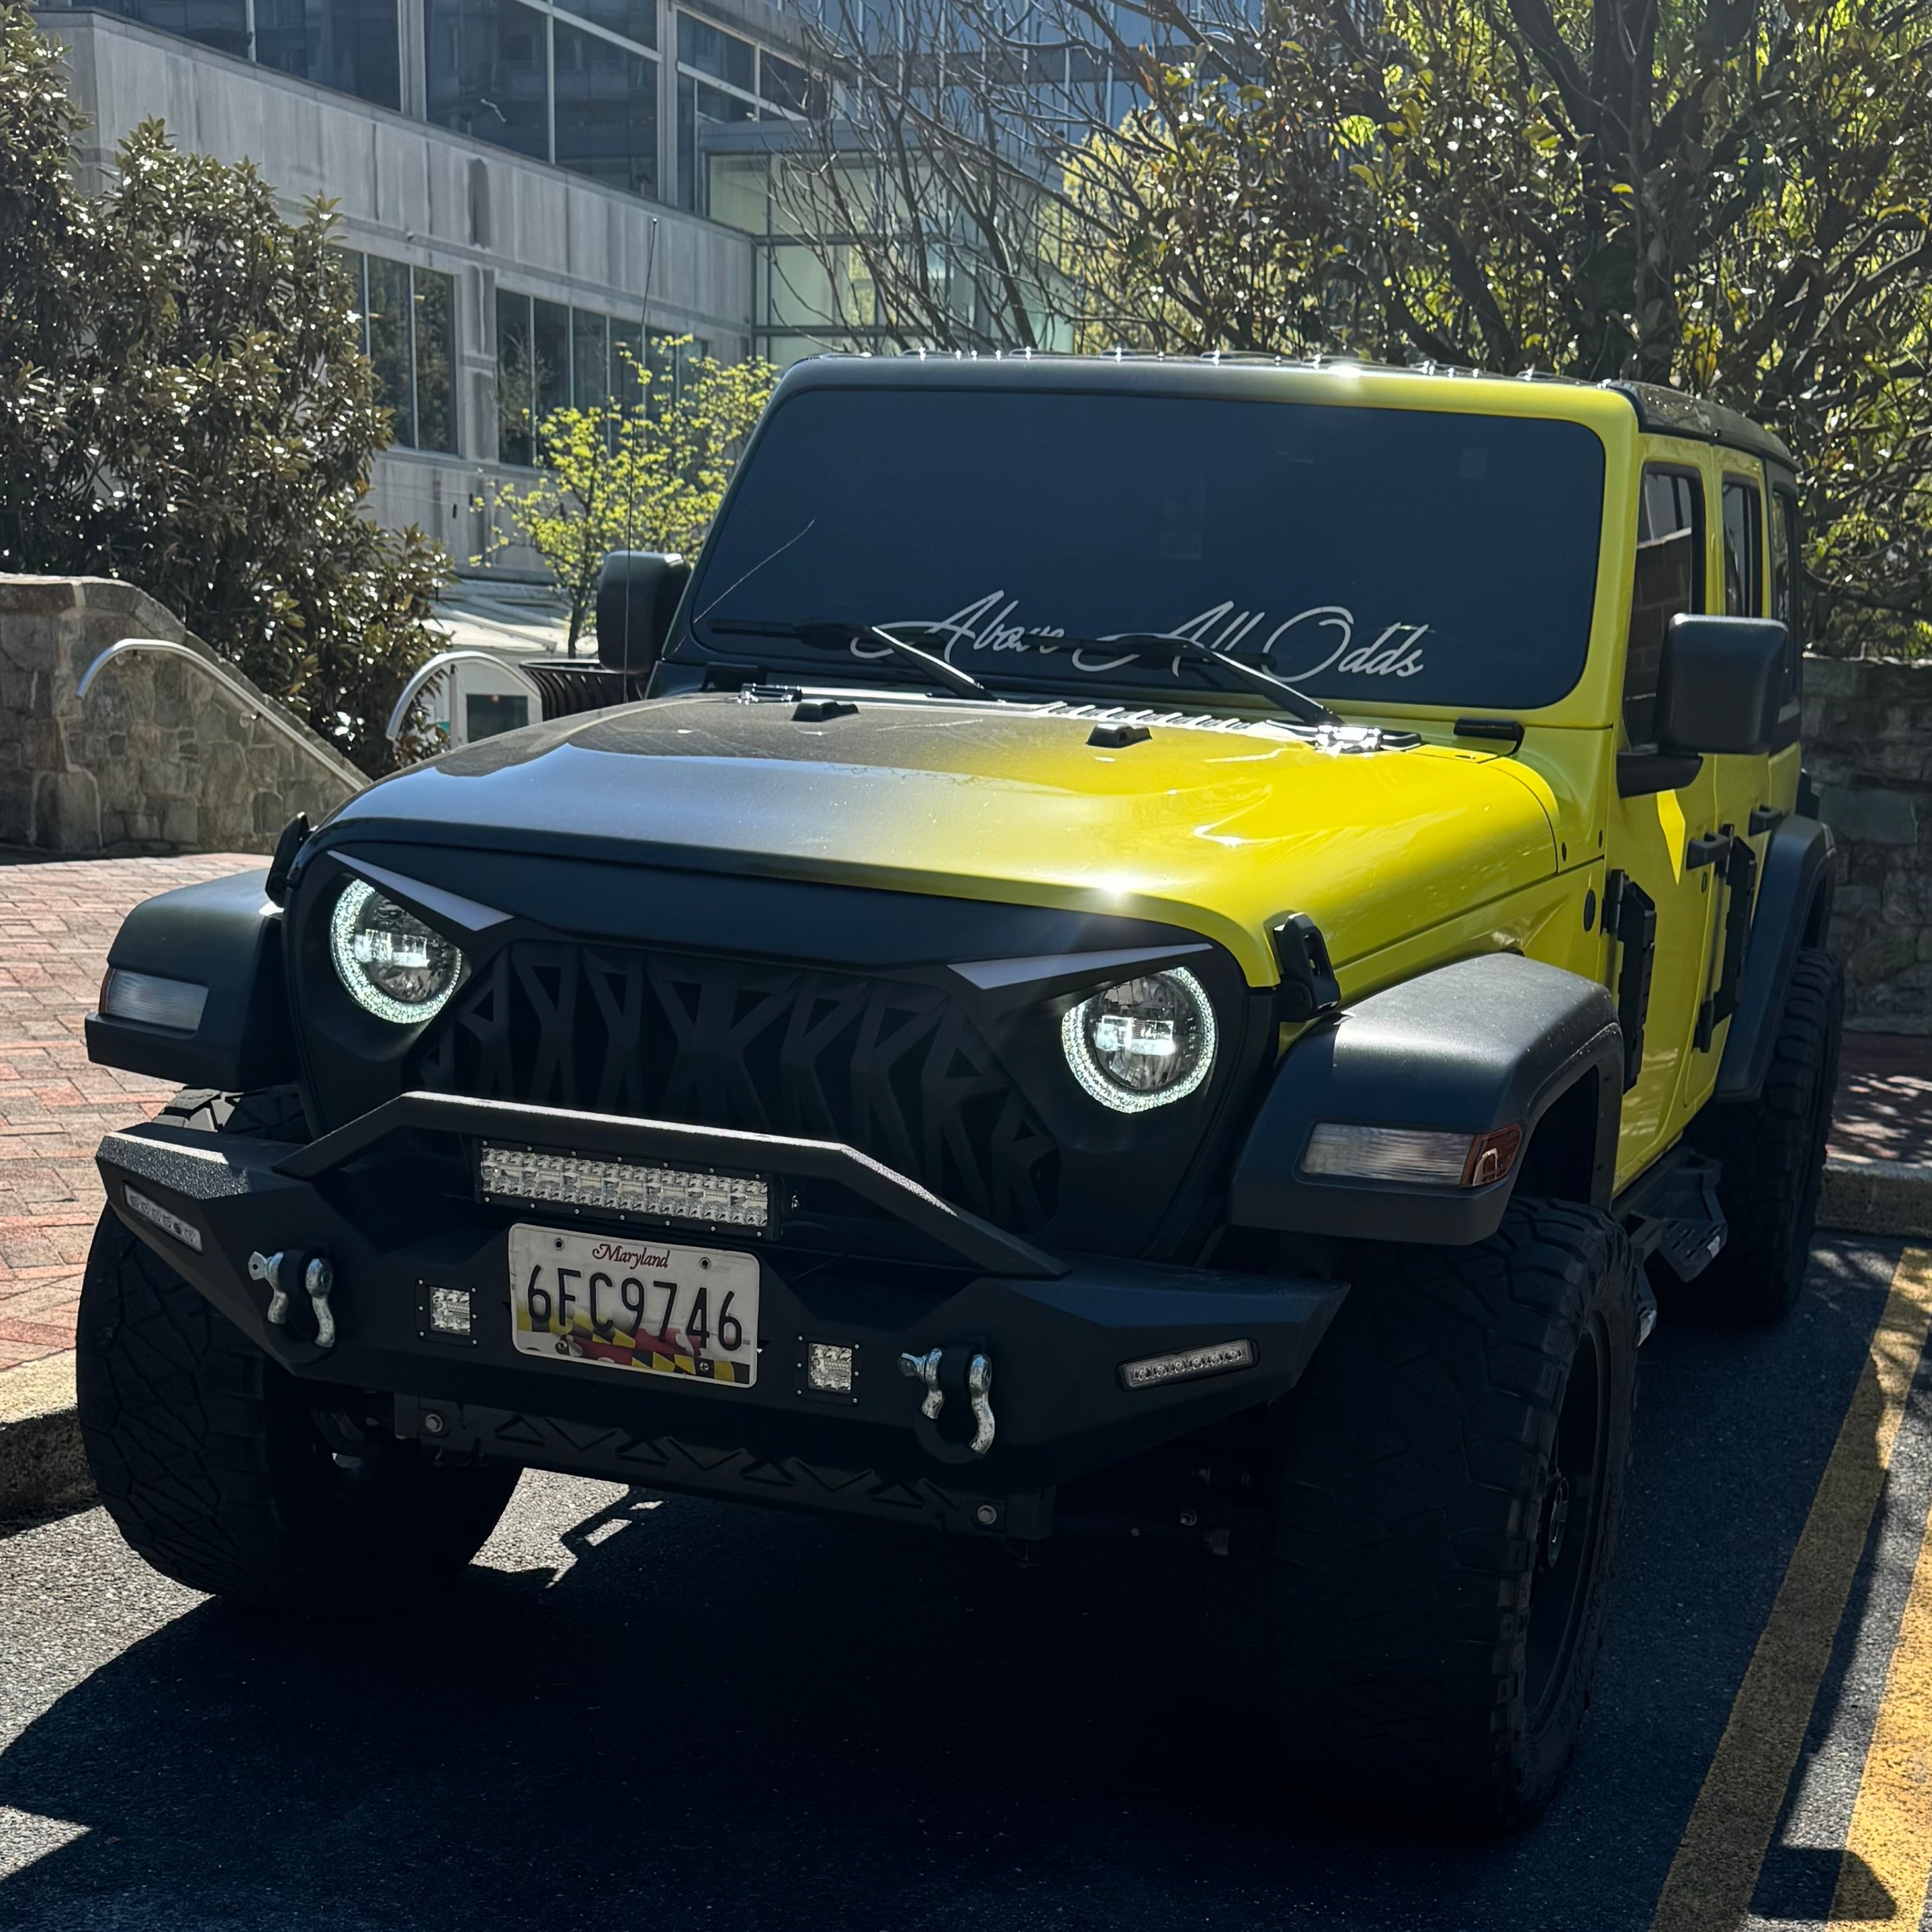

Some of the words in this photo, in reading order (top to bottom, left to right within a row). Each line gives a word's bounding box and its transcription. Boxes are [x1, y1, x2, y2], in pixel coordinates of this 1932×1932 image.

[1071, 600, 1265, 677] All
[1261, 606, 1430, 683] Odds
[592, 1243, 671, 1270] Maryland
[527, 1264, 742, 1351] 6FC9746
